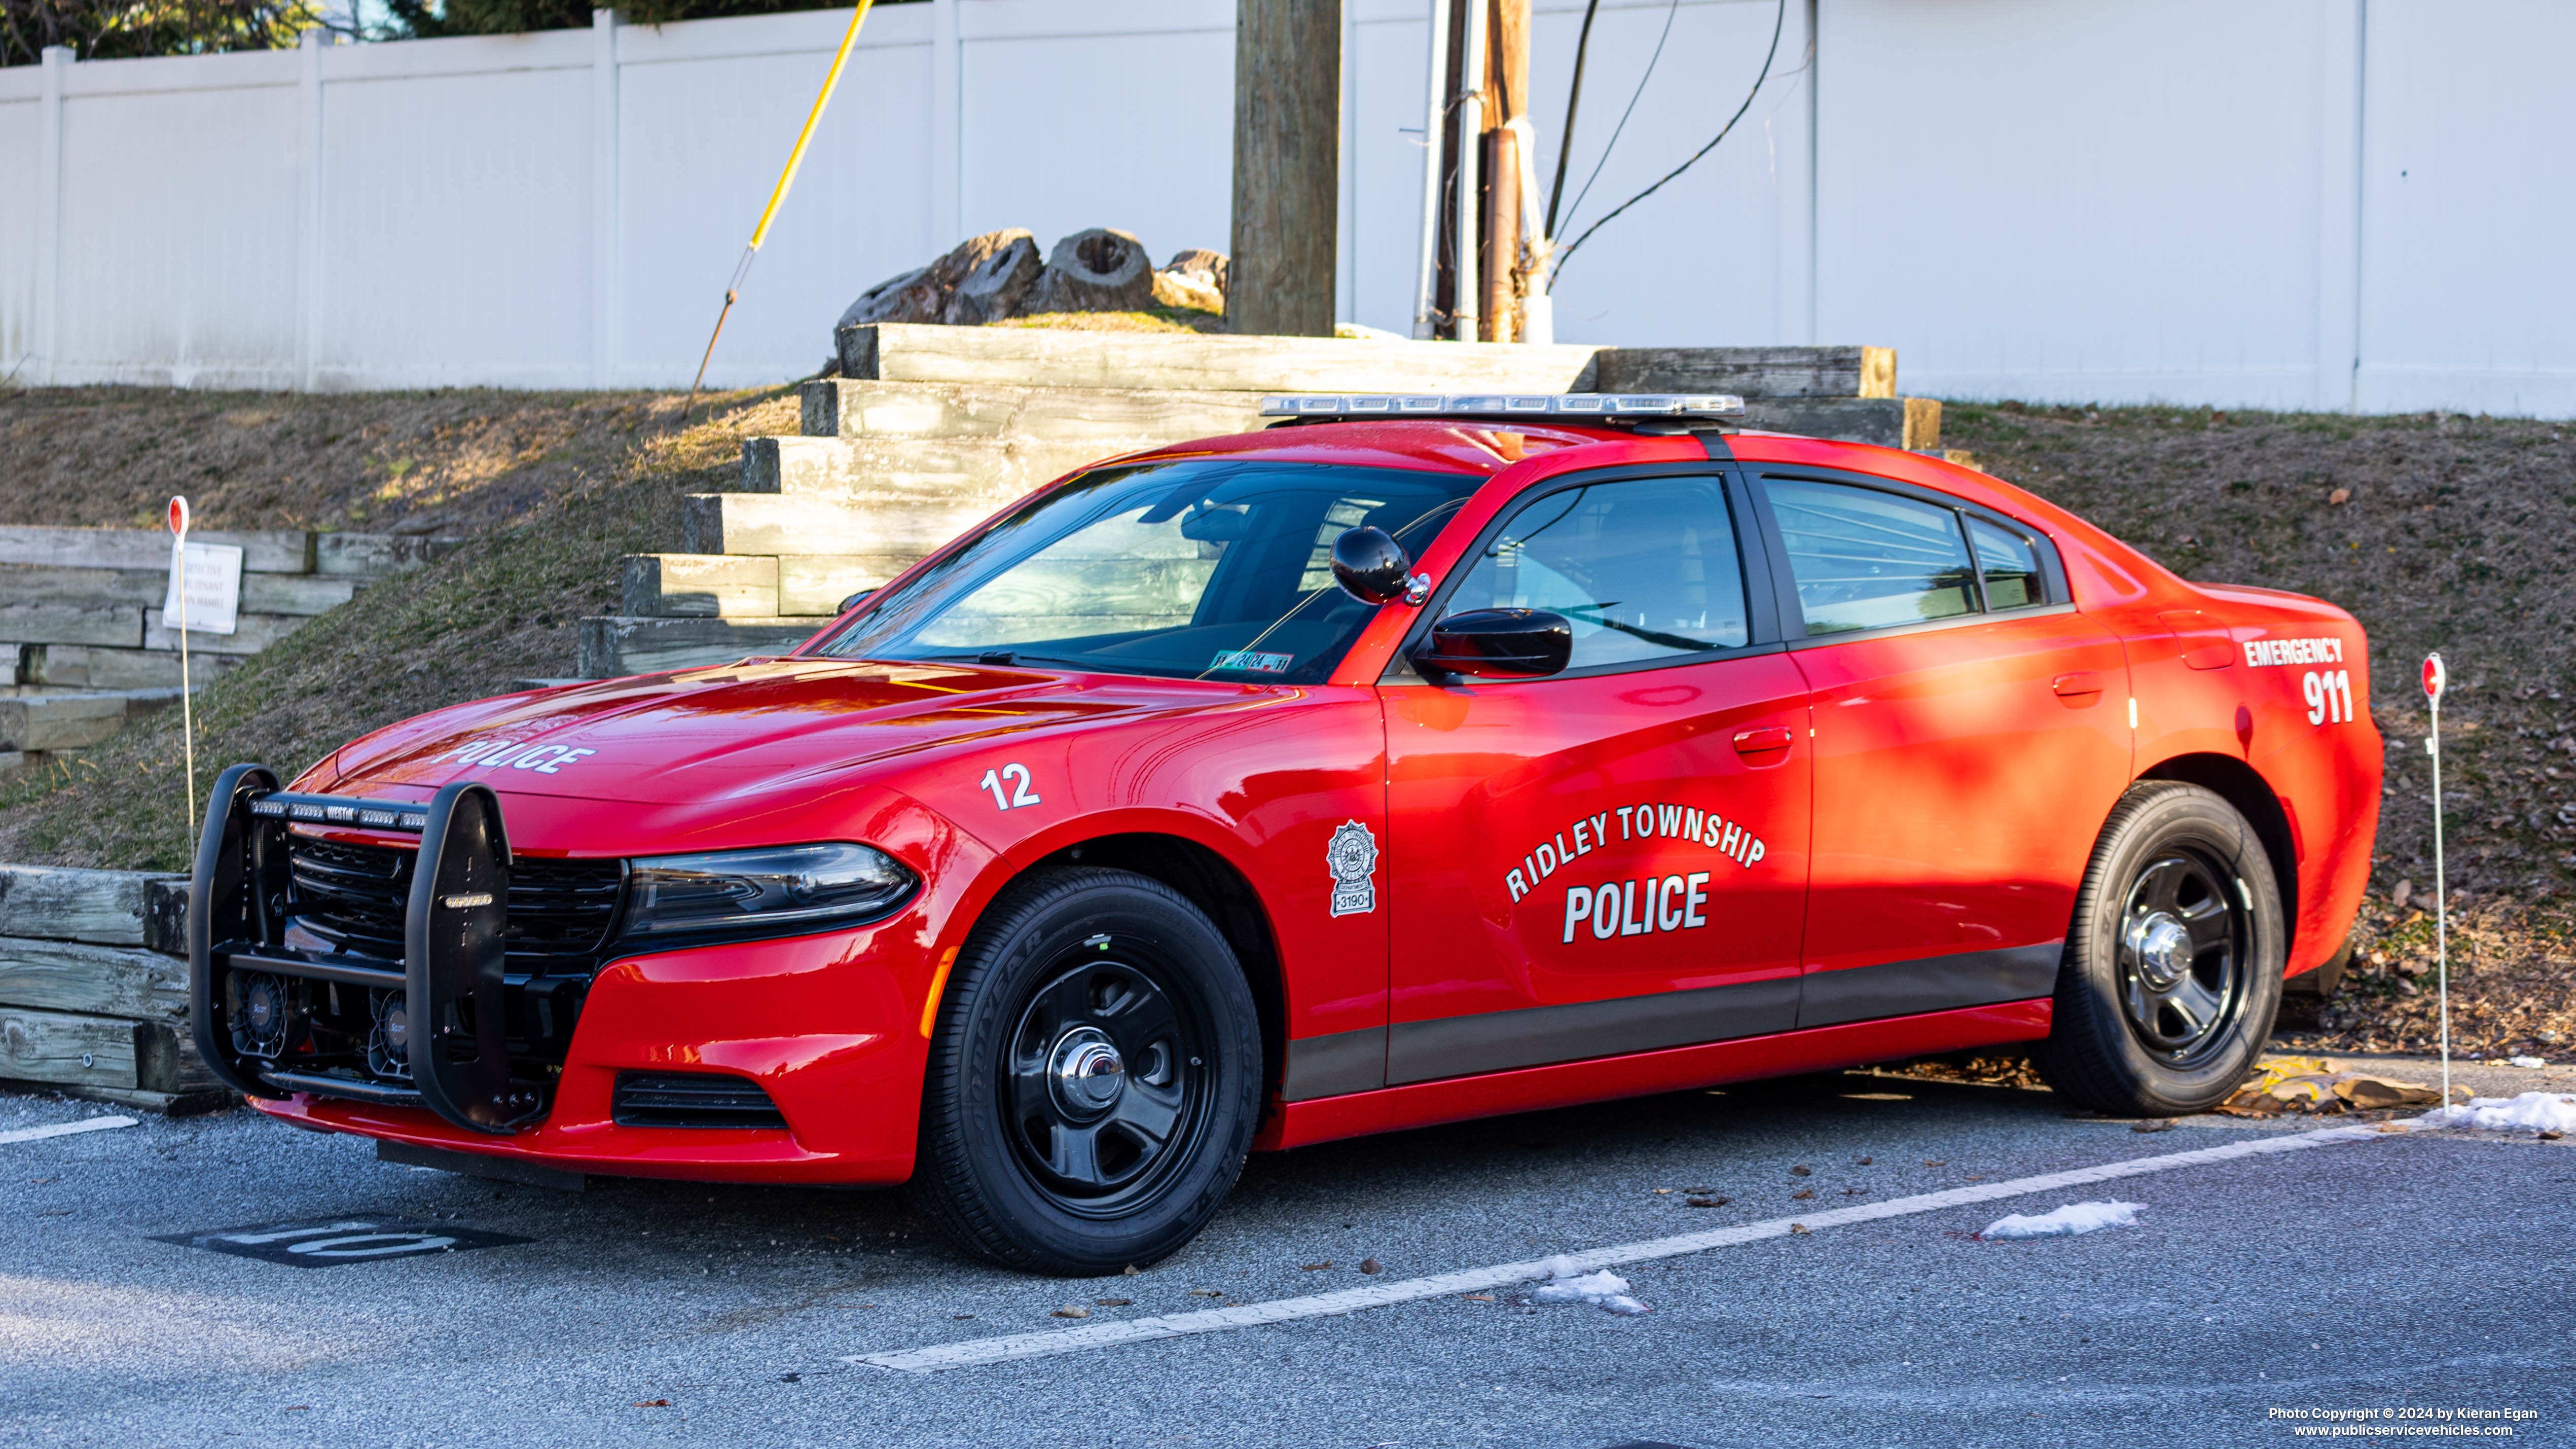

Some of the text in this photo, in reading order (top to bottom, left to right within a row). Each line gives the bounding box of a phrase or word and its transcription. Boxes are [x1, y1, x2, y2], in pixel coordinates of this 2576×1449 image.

[185, 563, 222, 577] DETECTIVE
[175, 595, 195, 607] JHN
[1237, 654, 1252, 667] 24
[1251, 654, 1288, 670] 24 11
[2243, 638, 2343, 667] EMERGENCY
[2303, 669, 2353, 726] 911
[429, 740, 598, 774] POLICE
[979, 762, 1041, 811] 12
[1504, 803, 1766, 904] RIDLEY TOWNSHIP
[1341, 867, 1367, 879] POLICE
[1340, 894, 1365, 908] 3190
[1562, 871, 1711, 944] POLICE
[970, 929, 1043, 1159] GOODYEAR
[1227, 990, 1254, 1128] EAGLE
